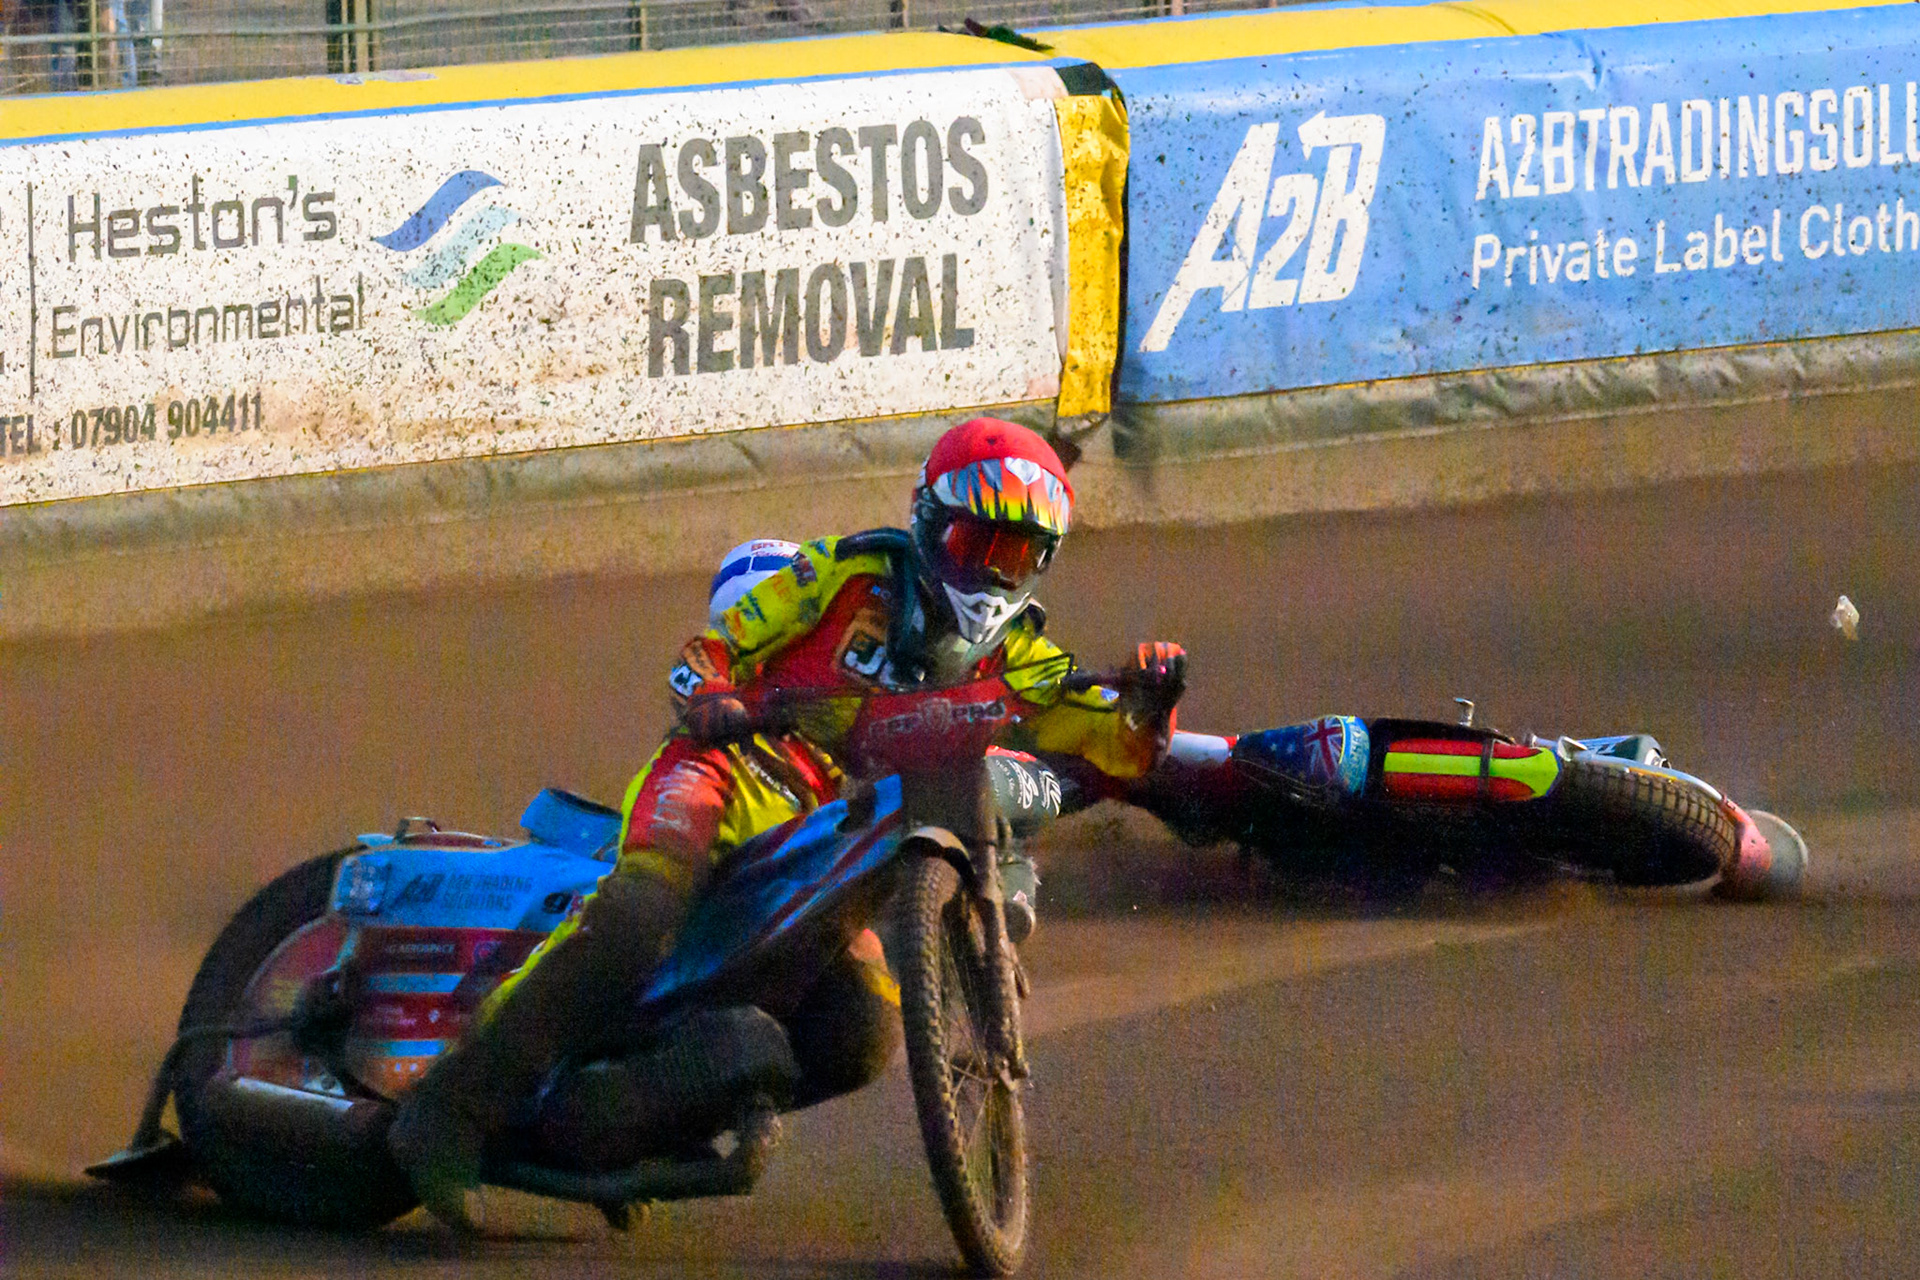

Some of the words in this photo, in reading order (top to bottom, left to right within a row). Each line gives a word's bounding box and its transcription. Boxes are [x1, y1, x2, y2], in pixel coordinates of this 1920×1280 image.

[67, 173, 339, 262] Heston's
[629, 116, 989, 244] ASBESTOS
[1138, 110, 1387, 354] A2B
[1471, 226, 1638, 290] Private
[1653, 208, 1784, 274] Label
[51, 271, 365, 360] Environmental
[647, 253, 975, 378] REMOVAL
[71, 402, 157, 450] 07904
[167, 390, 262, 440] 904411
